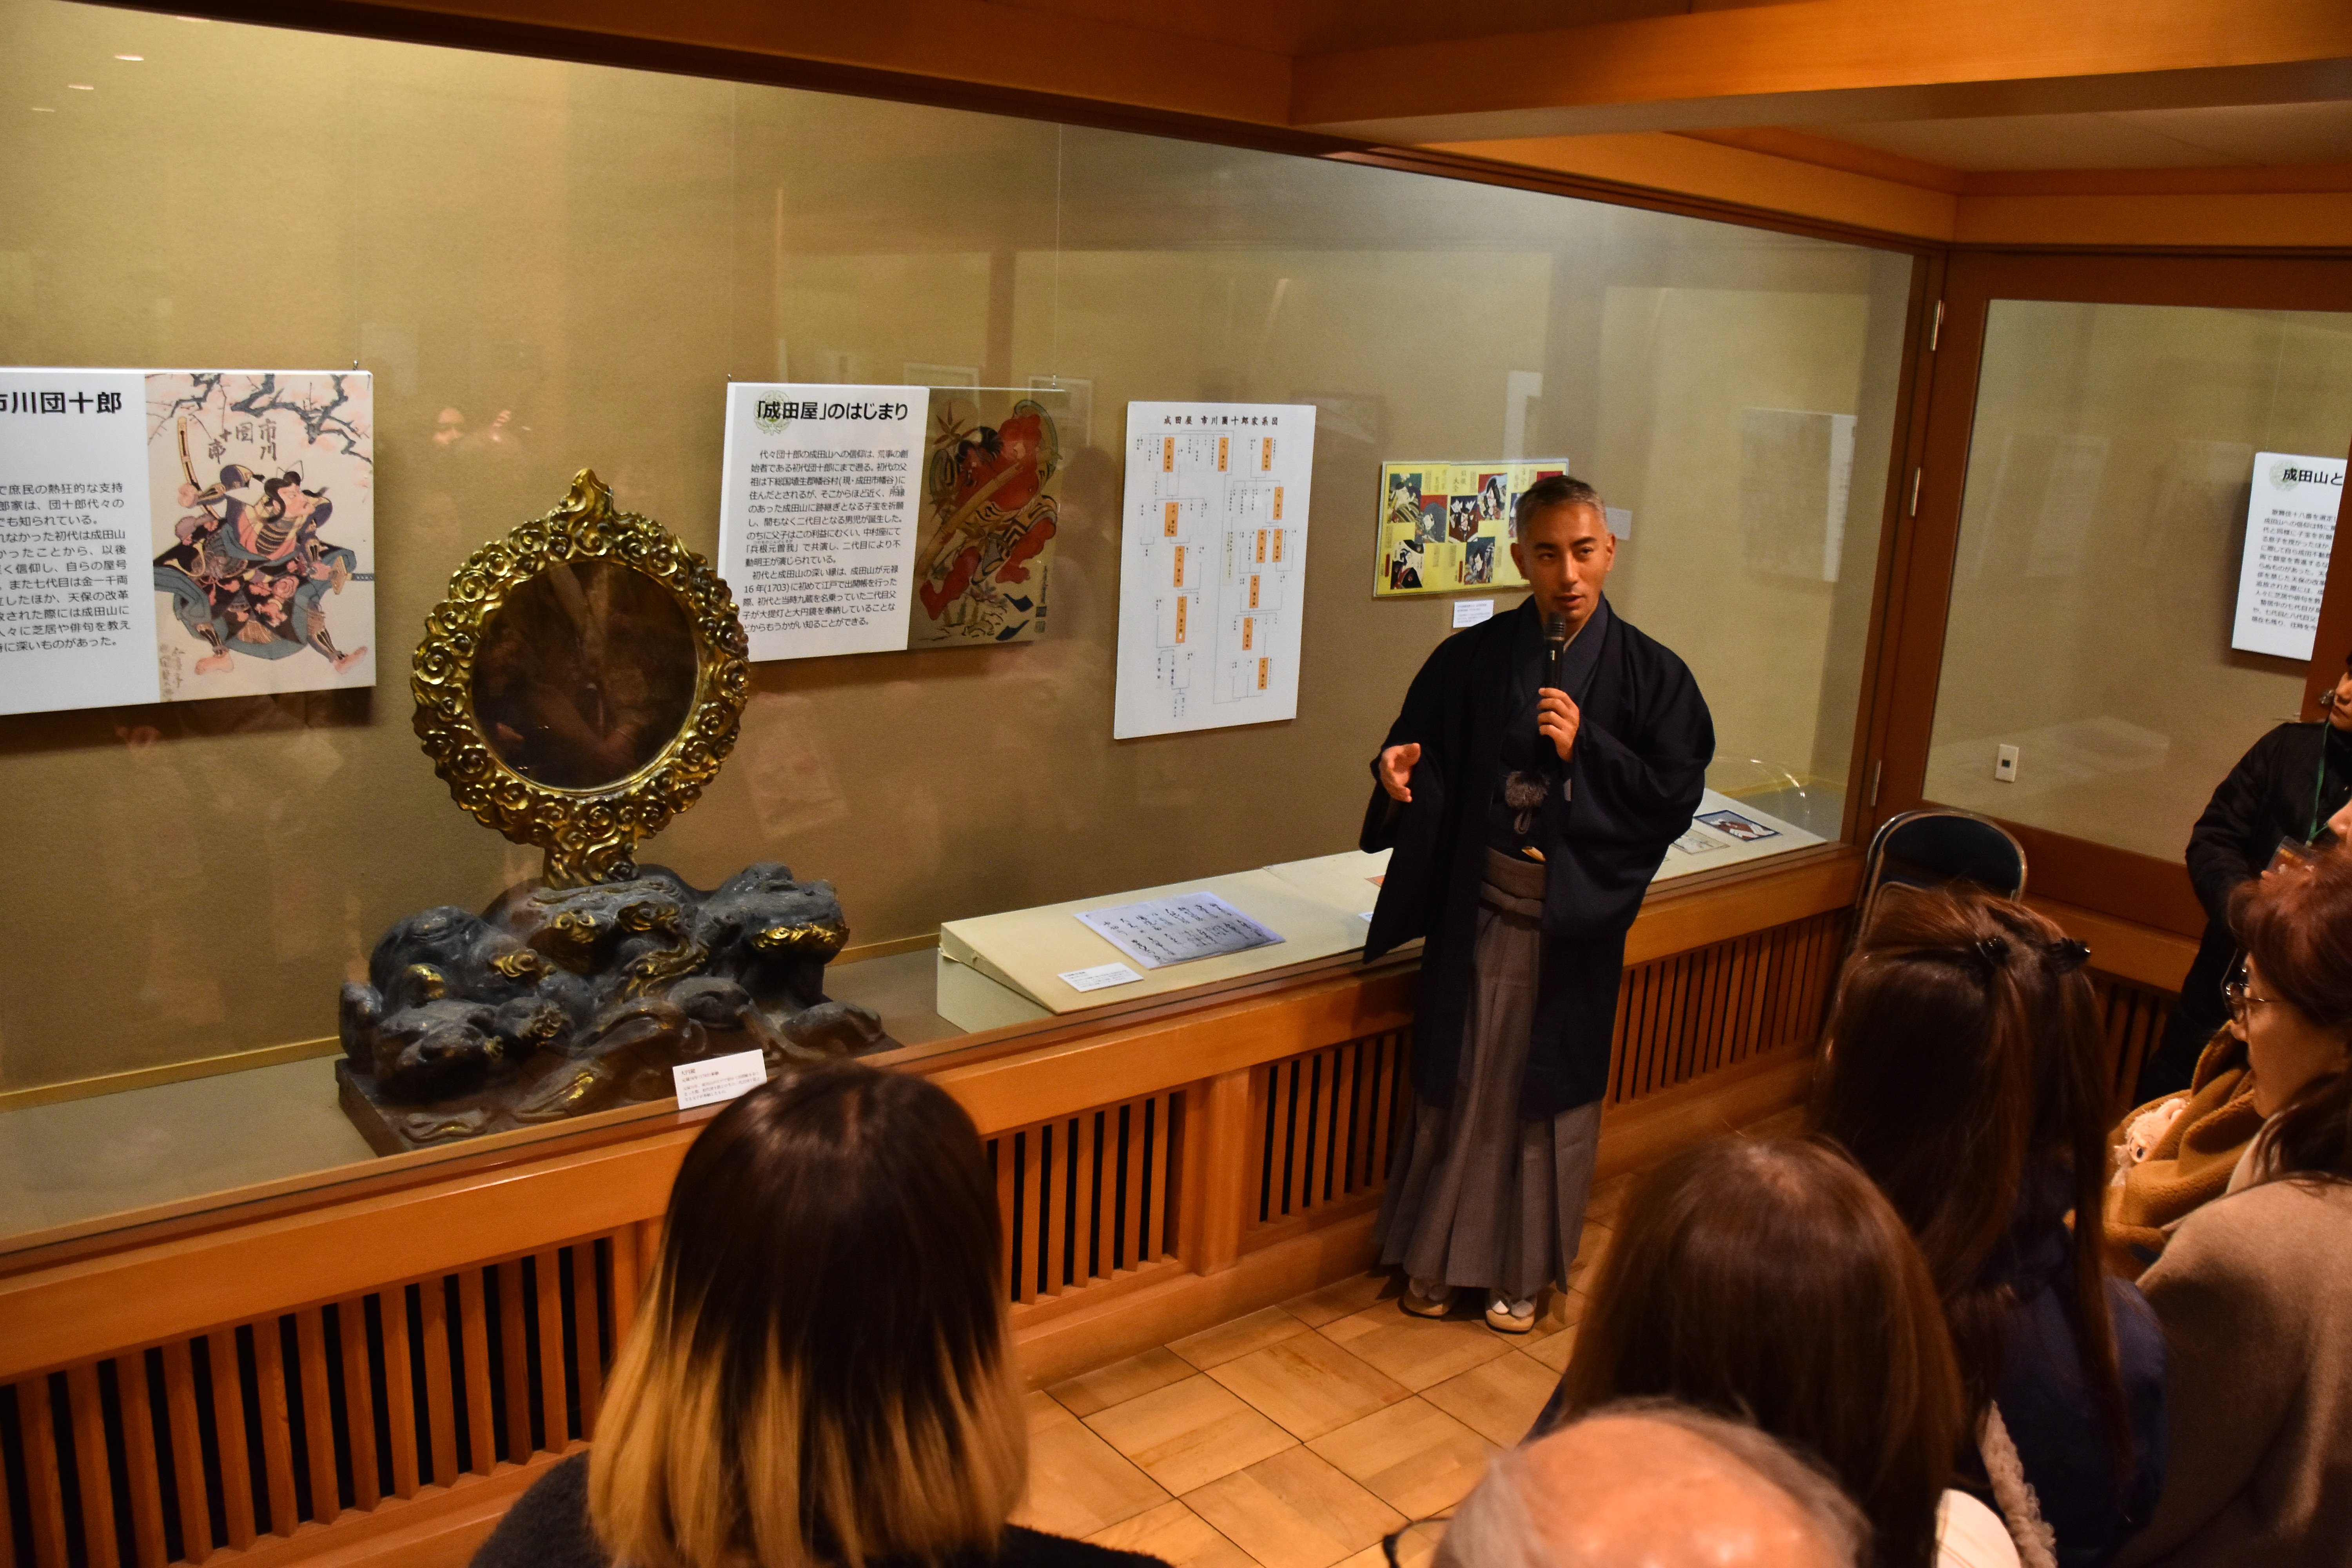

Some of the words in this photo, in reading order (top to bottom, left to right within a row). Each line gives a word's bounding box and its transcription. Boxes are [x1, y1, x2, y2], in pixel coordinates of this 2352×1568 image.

[757, 401, 909, 421] 「成田屋」のはじまり
[2282, 468, 2343, 486] 成田山と
[0, 560, 126, 574] く信仰し、自らの屋号
[0, 636, 116, 653] に深いものがあった。
